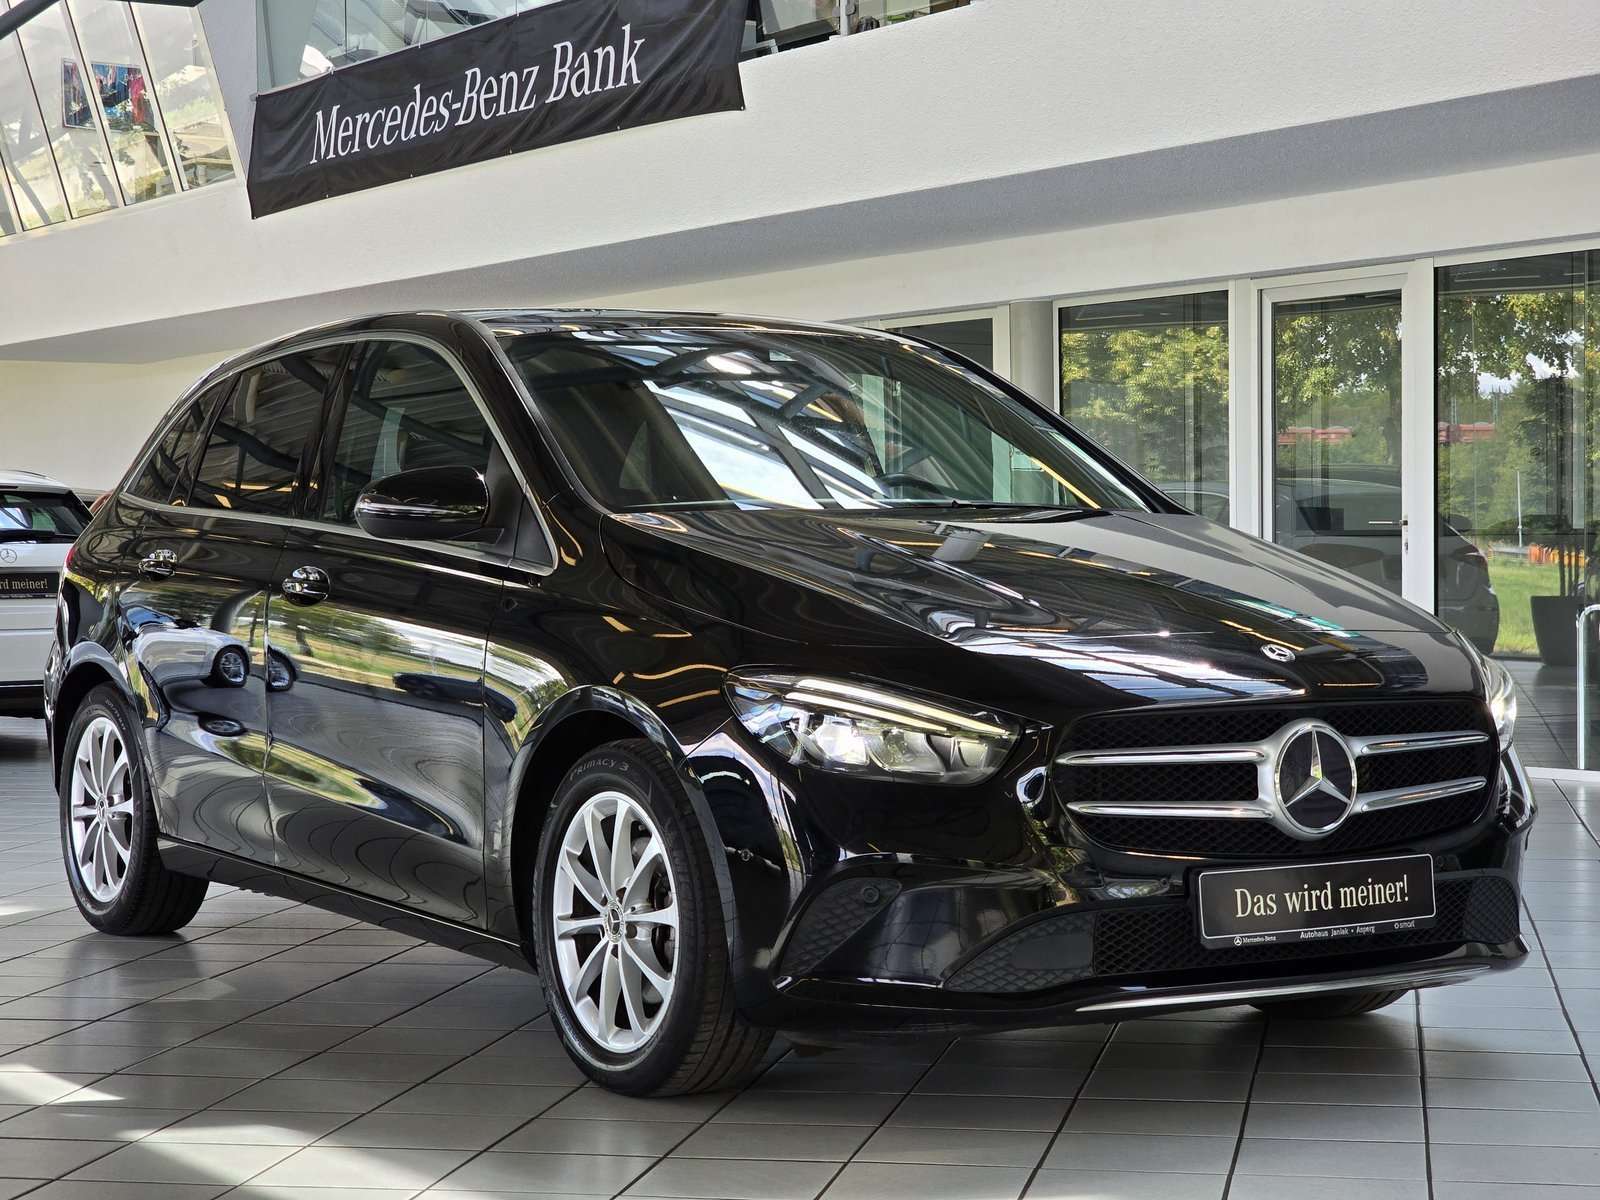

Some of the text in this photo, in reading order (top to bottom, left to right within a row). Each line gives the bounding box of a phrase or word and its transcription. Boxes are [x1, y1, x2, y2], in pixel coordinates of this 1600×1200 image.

[309, 23, 646, 164] Mercedes-Benz Bank
[12, 578, 48, 590] meiner!
[1234, 874, 1409, 918] Das wird meiner!
[1242, 935, 1277, 944] Mercedes-Benz
[1300, 930, 1329, 939] Autohaus
